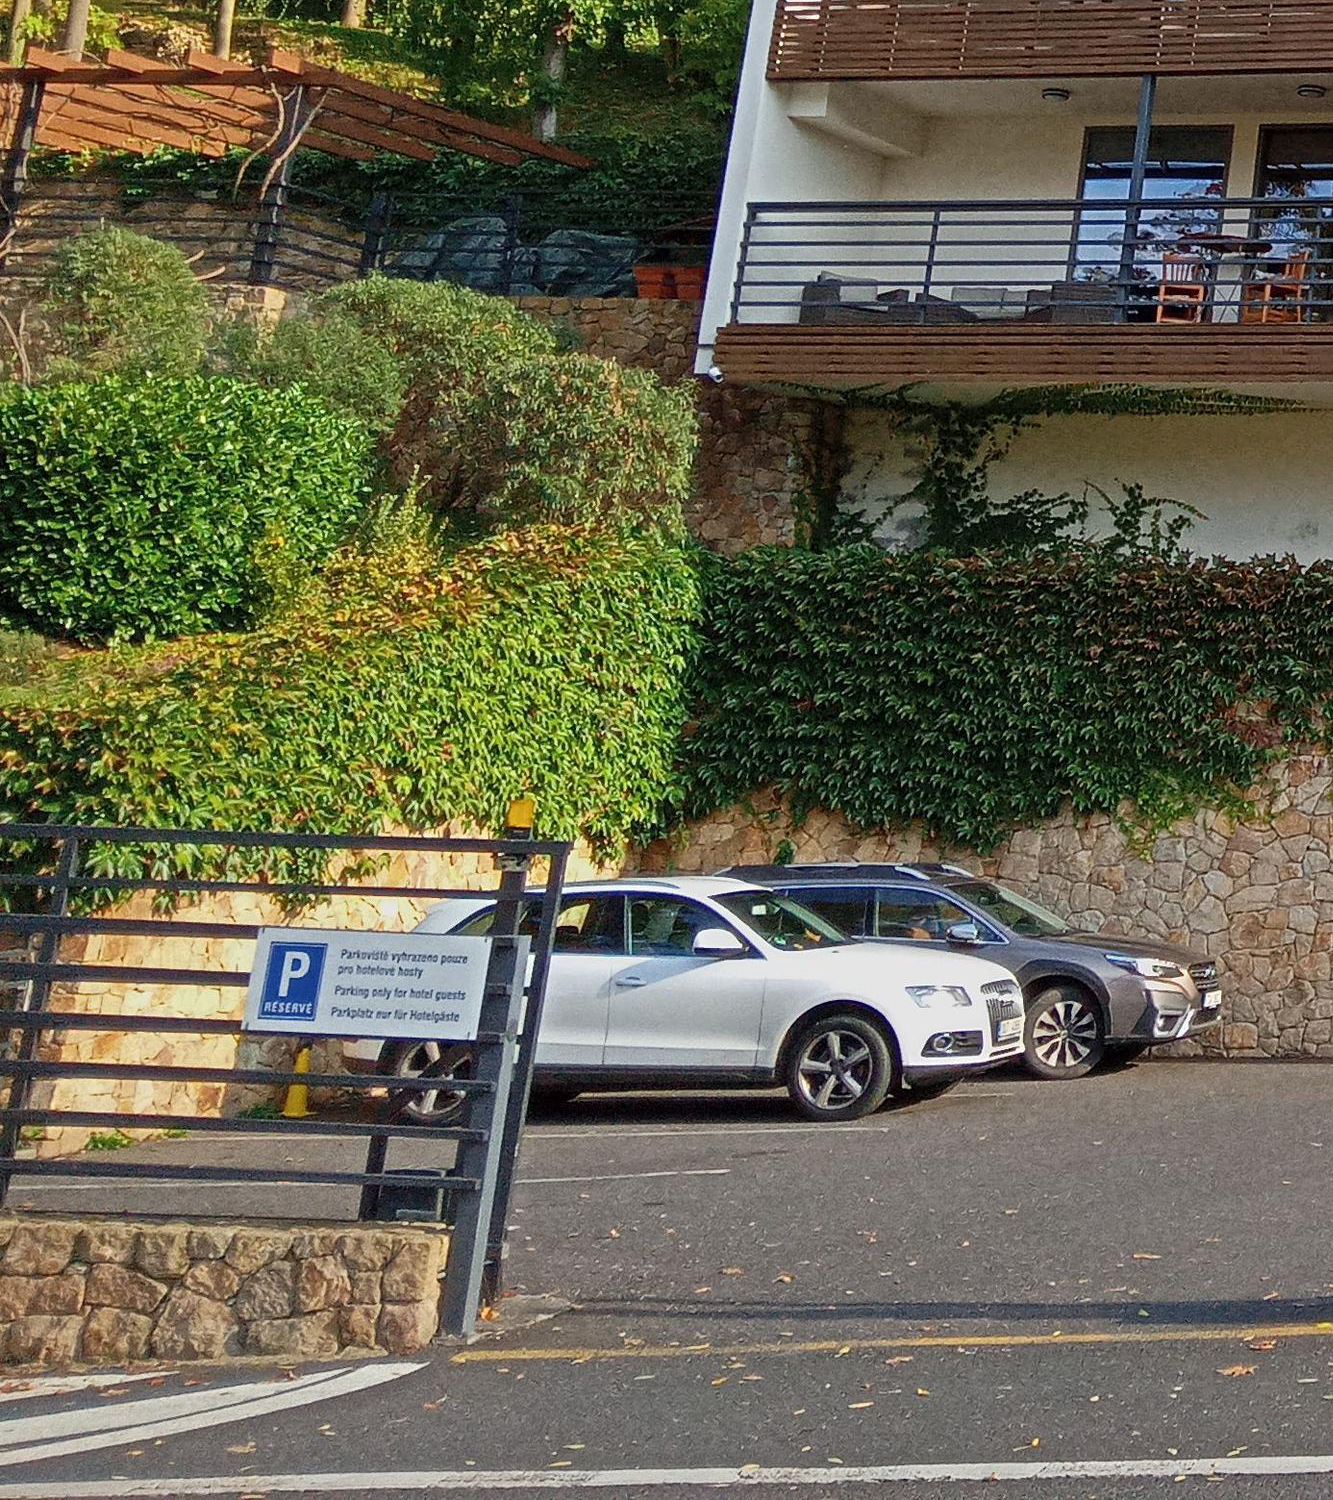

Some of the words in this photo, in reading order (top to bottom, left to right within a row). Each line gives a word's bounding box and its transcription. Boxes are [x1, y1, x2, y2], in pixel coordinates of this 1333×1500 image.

[340, 948, 389, 962] Parkoviště
[391, 951, 438, 964] vyhrazeno
[440, 954, 468, 965] pouze
[278, 951, 311, 997] P
[337, 964, 354, 975] pro
[356, 964, 395, 977] hotelové
[398, 967, 424, 979] hosty
[334, 985, 370, 999] Parking
[372, 986, 392, 1000] only
[394, 988, 407, 998] for
[409, 988, 433, 1000] hotel
[435, 990, 466, 1002] guests
[331, 1006, 373, 1020] Parkplatz
[376, 1010, 391, 1020] nur
[394, 1008, 407, 1020] für
[409, 1009, 460, 1023] Hotelgäste
